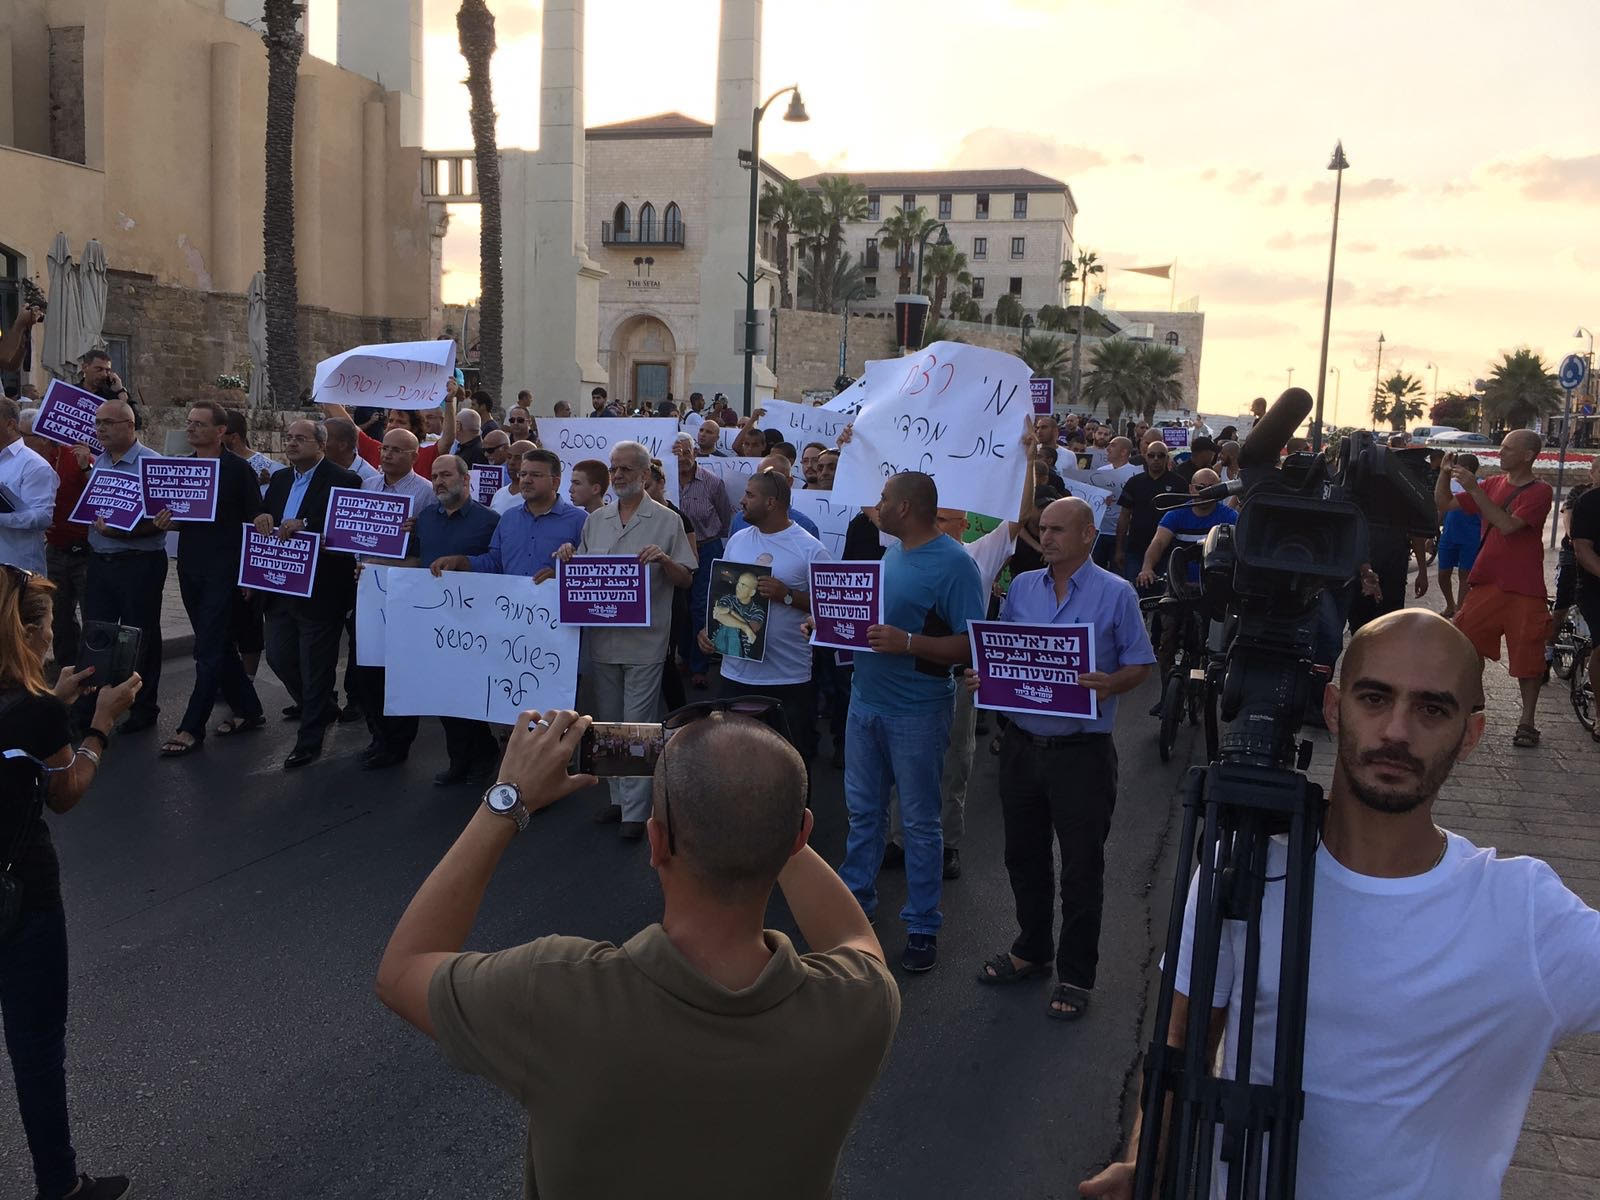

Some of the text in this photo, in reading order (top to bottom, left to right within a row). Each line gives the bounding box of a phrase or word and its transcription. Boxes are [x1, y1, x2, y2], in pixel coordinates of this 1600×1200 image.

[898, 354, 1018, 415] מי רצח
[560, 428, 608, 450] 2000
[893, 414, 1005, 459] את מהדי
[149, 465, 209, 476] לא לאלימות
[97, 476, 133, 489] לאלימות
[150, 488, 206, 499] המשטרתית
[89, 496, 135, 510] המשטרתית
[340, 498, 402, 512] לא לאלימות
[337, 520, 397, 535] המשטרתית
[294, 540, 308, 550] לא
[251, 556, 304, 573] המשטרתית
[568, 564, 636, 575] לא לאלימות
[816, 572, 871, 586] לא לאלימות
[413, 586, 475, 610] את
[569, 591, 636, 601] המשטרתית
[820, 604, 869, 619] המשטרתית
[985, 633, 1076, 650] לא לאלימות
[433, 625, 560, 675] השוטר הפושע
[991, 664, 1077, 683] המשטרתית
[486, 672, 540, 717] לדין
[1014, 688, 1029, 696] ביחד
